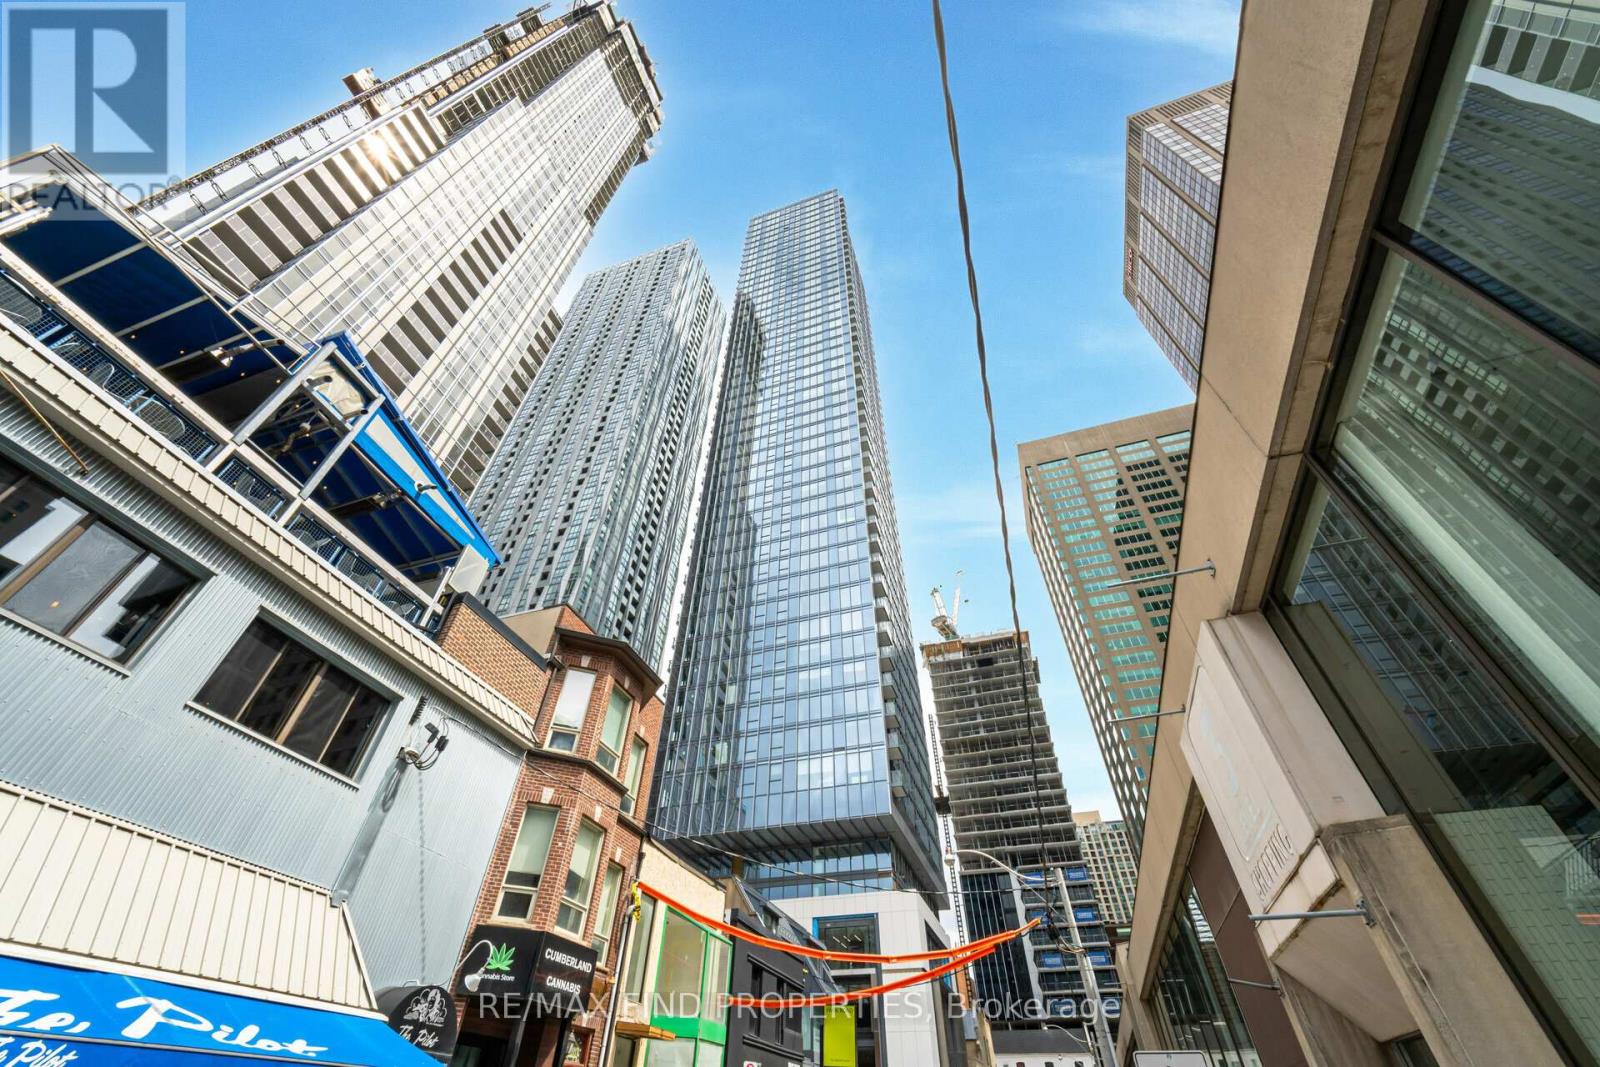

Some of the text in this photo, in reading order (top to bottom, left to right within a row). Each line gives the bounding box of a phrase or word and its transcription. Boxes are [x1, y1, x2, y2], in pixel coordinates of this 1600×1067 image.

[545, 948, 593, 973] CUMBERLAND
[480, 972, 516, 982] annabis Store
[546, 976, 581, 994] CANNABIS
[115, 996, 329, 1057] Pilot
[413, 1028, 440, 1048] Pilot
